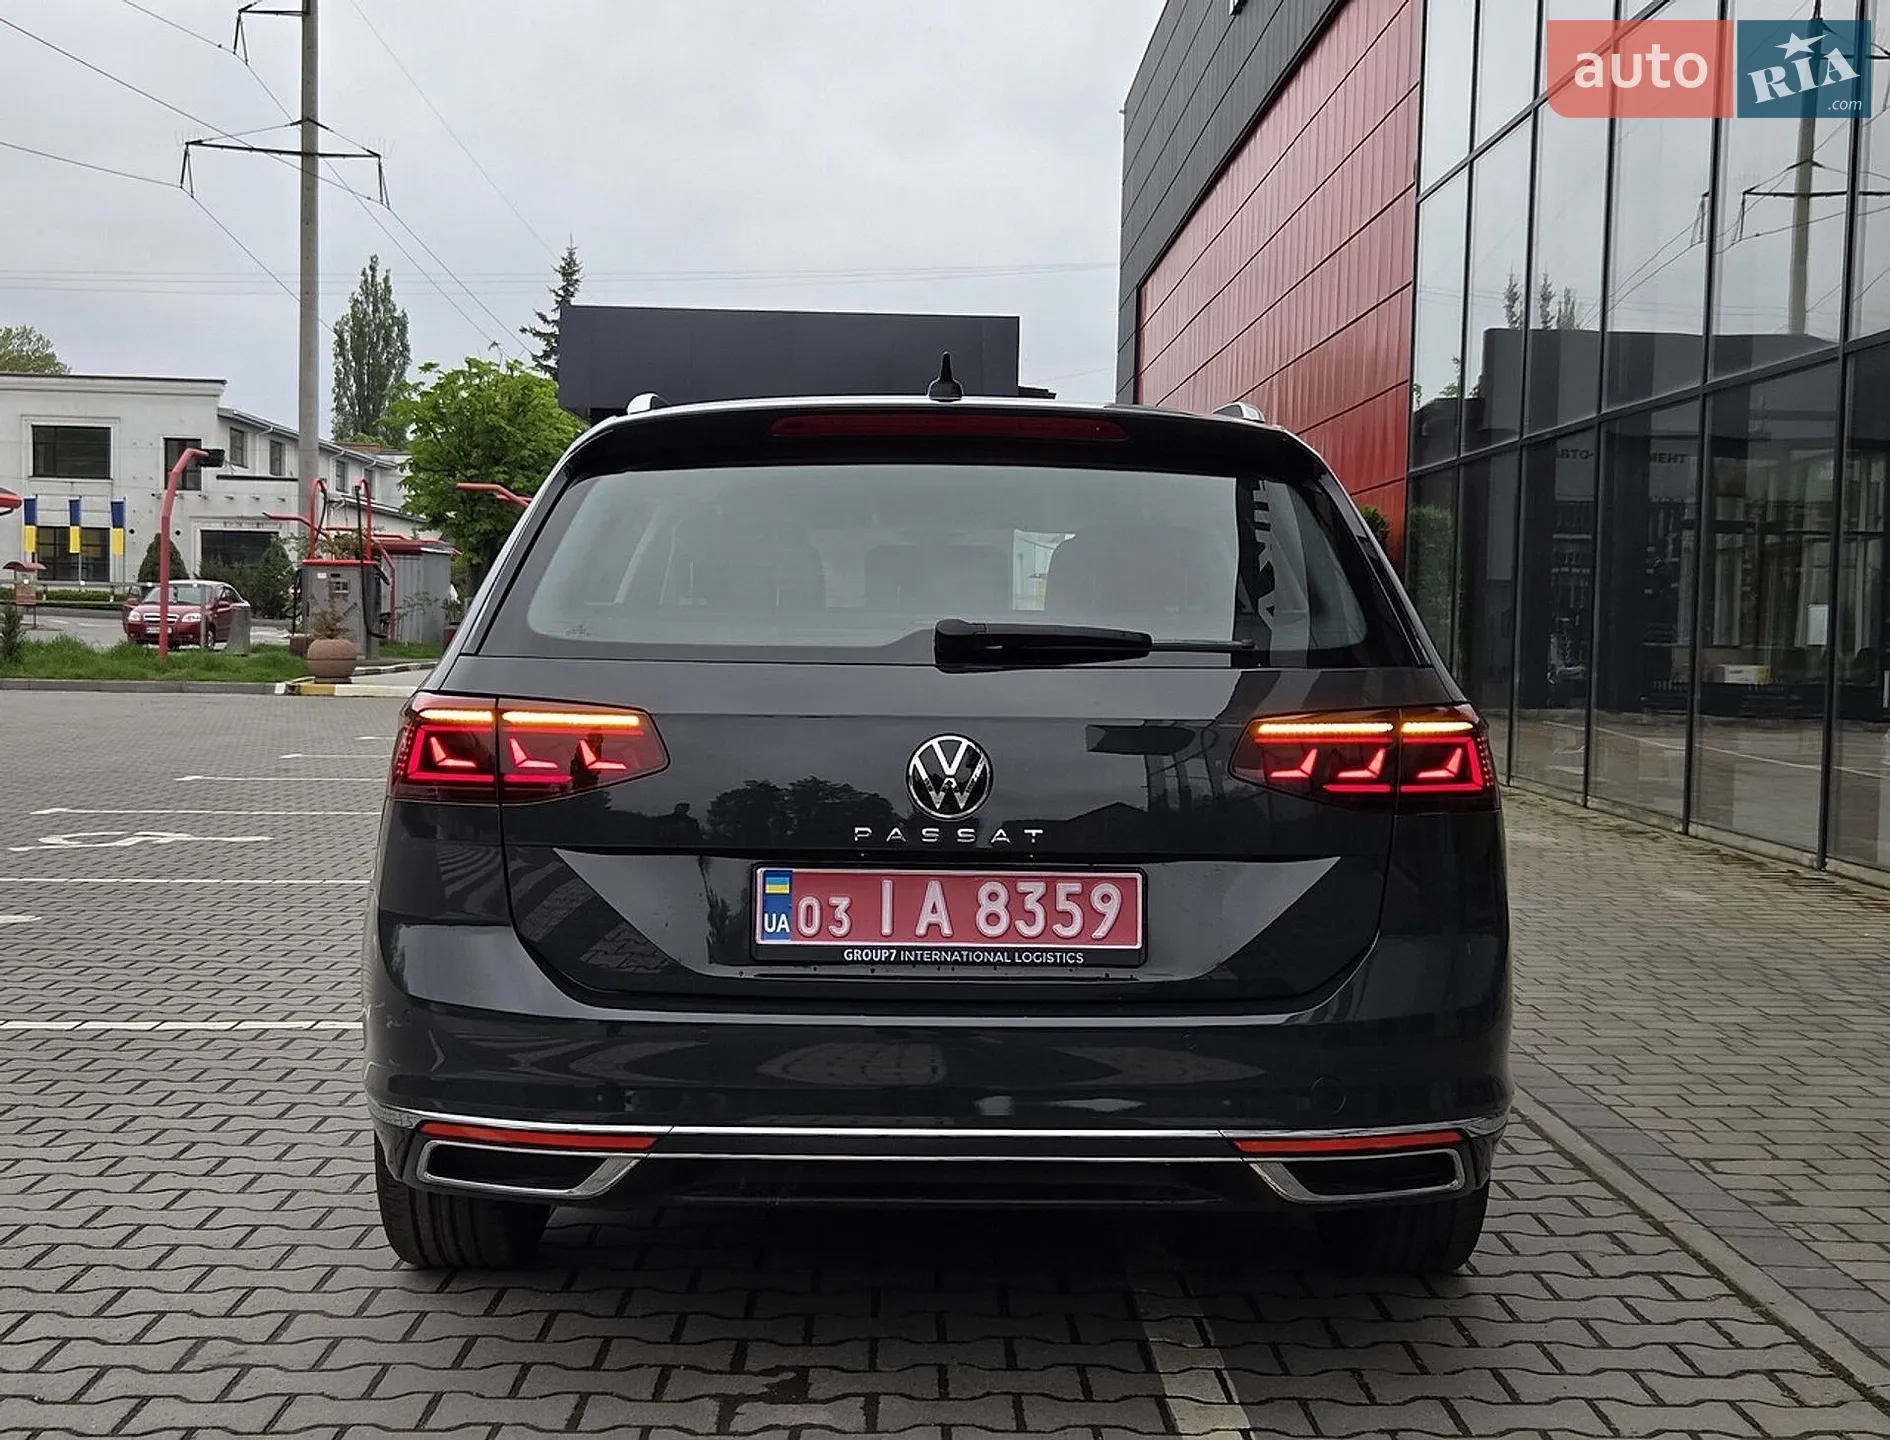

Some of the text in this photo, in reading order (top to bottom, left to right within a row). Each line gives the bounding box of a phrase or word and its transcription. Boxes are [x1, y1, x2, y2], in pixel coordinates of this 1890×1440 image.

[853, 827, 1043, 843] PASSAT
[798, 896, 852, 938] 03
[975, 881, 1123, 940] 8359
[764, 913, 790, 933] UA
[843, 949, 1084, 964] GROUP7 INTERNATIONAL LOGISTICS
